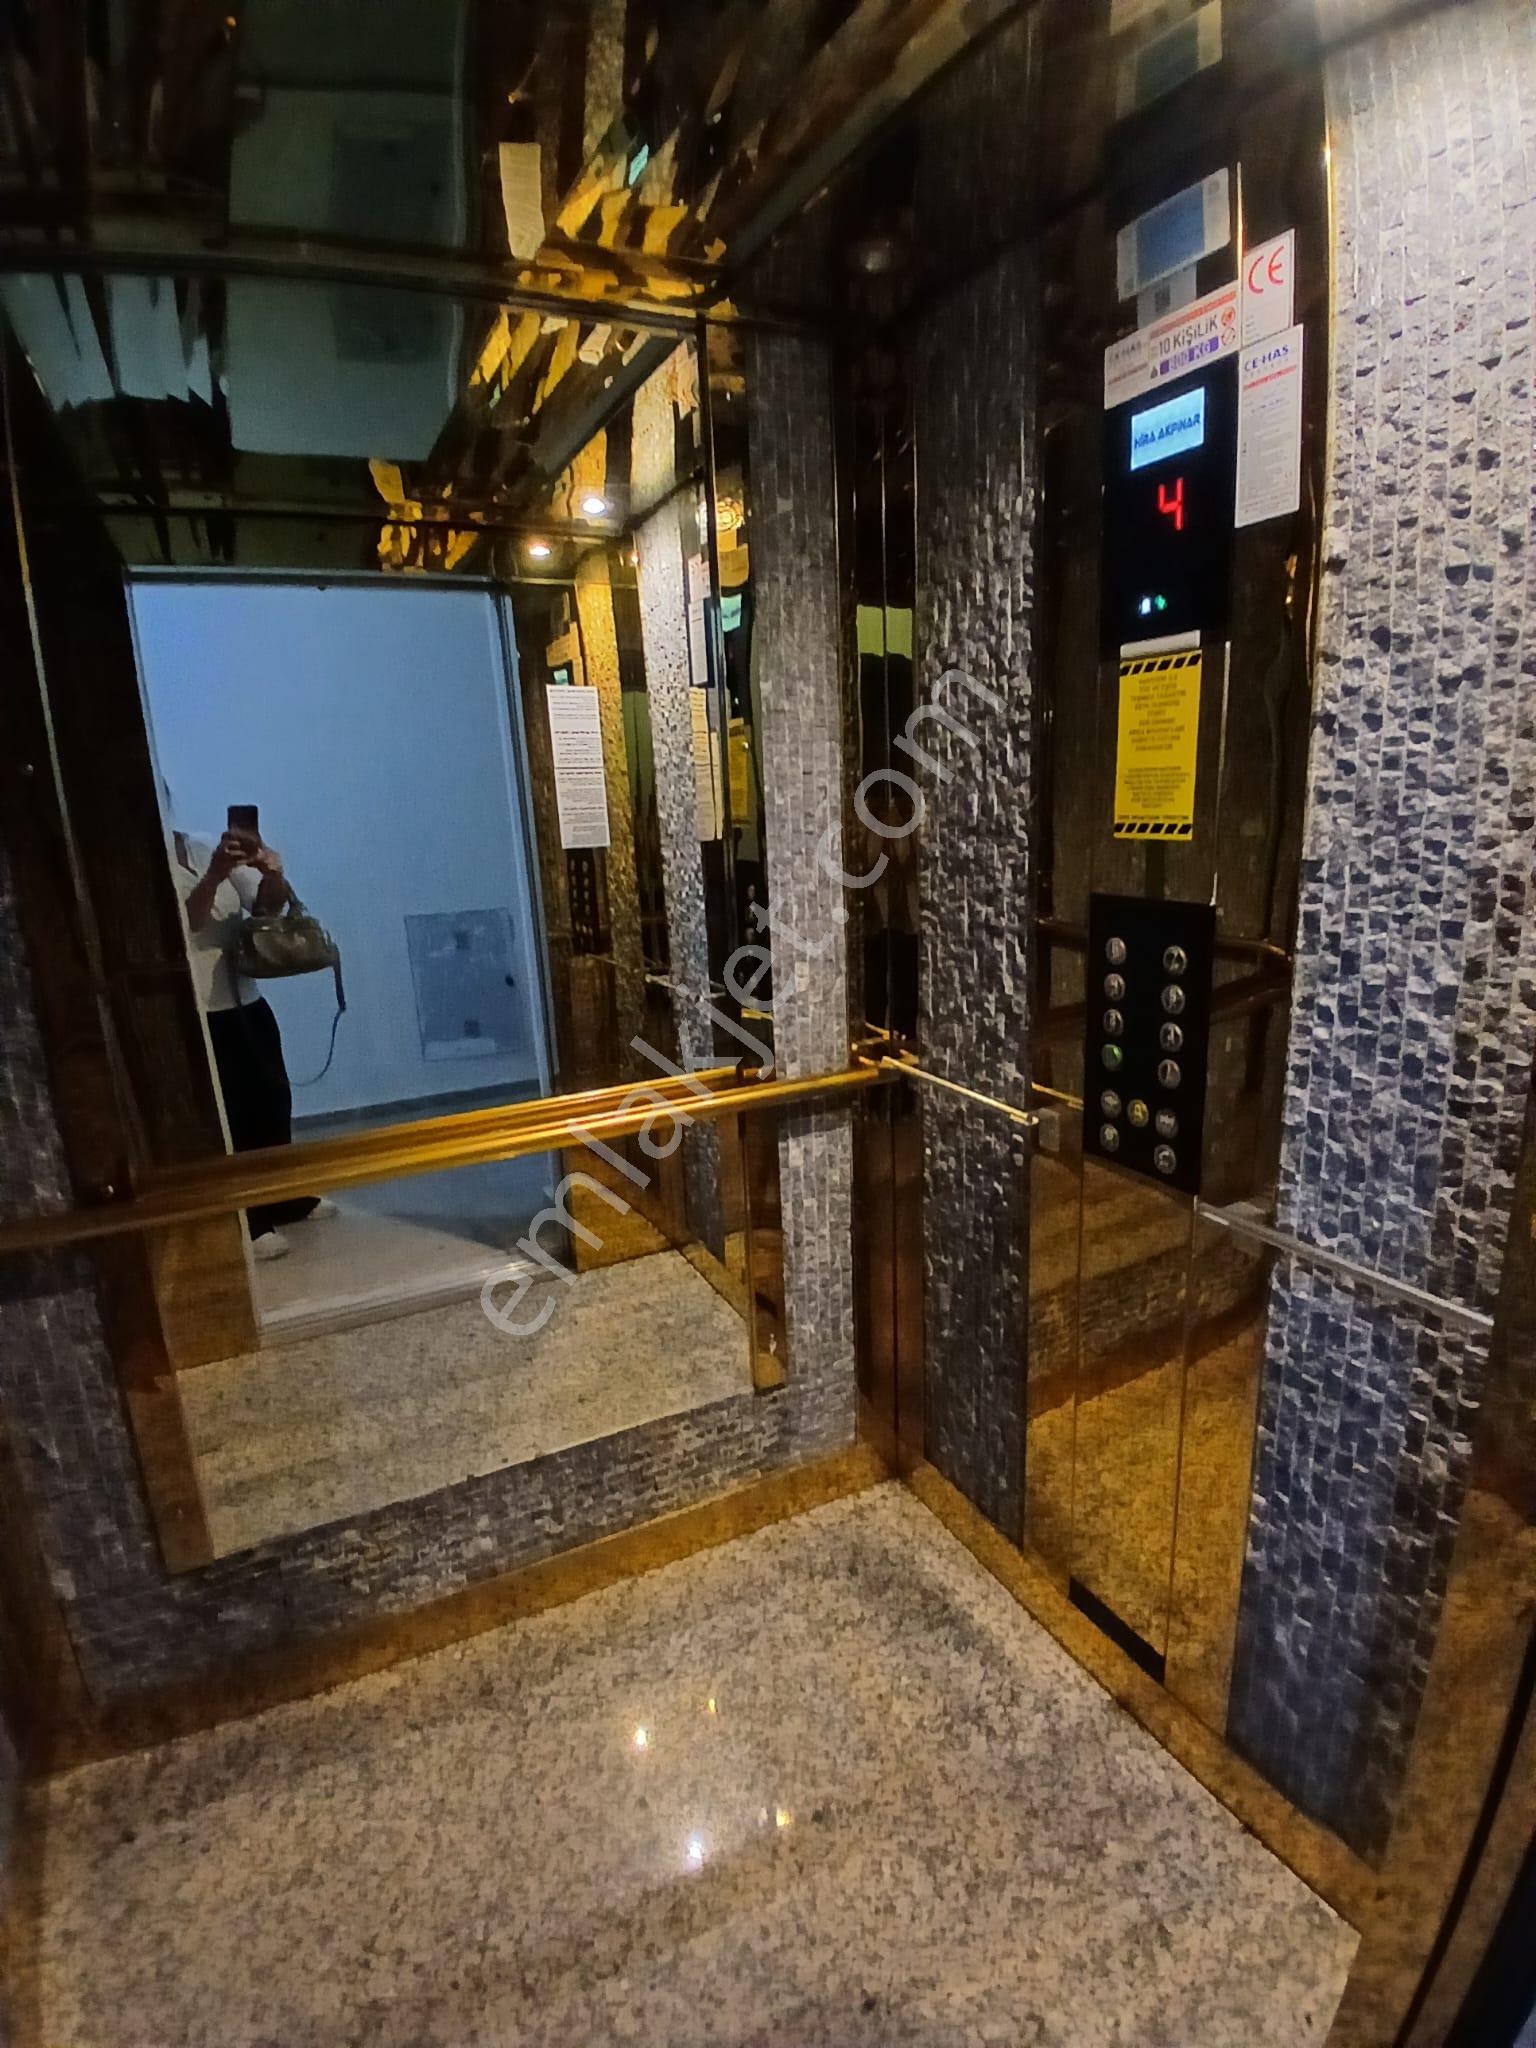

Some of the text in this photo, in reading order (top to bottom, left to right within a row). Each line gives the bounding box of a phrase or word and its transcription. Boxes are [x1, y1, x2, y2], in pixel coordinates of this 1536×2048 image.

[1248, 245, 1284, 294] CE
[1159, 337, 1171, 356] 10
[1158, 477, 1183, 530] 4
